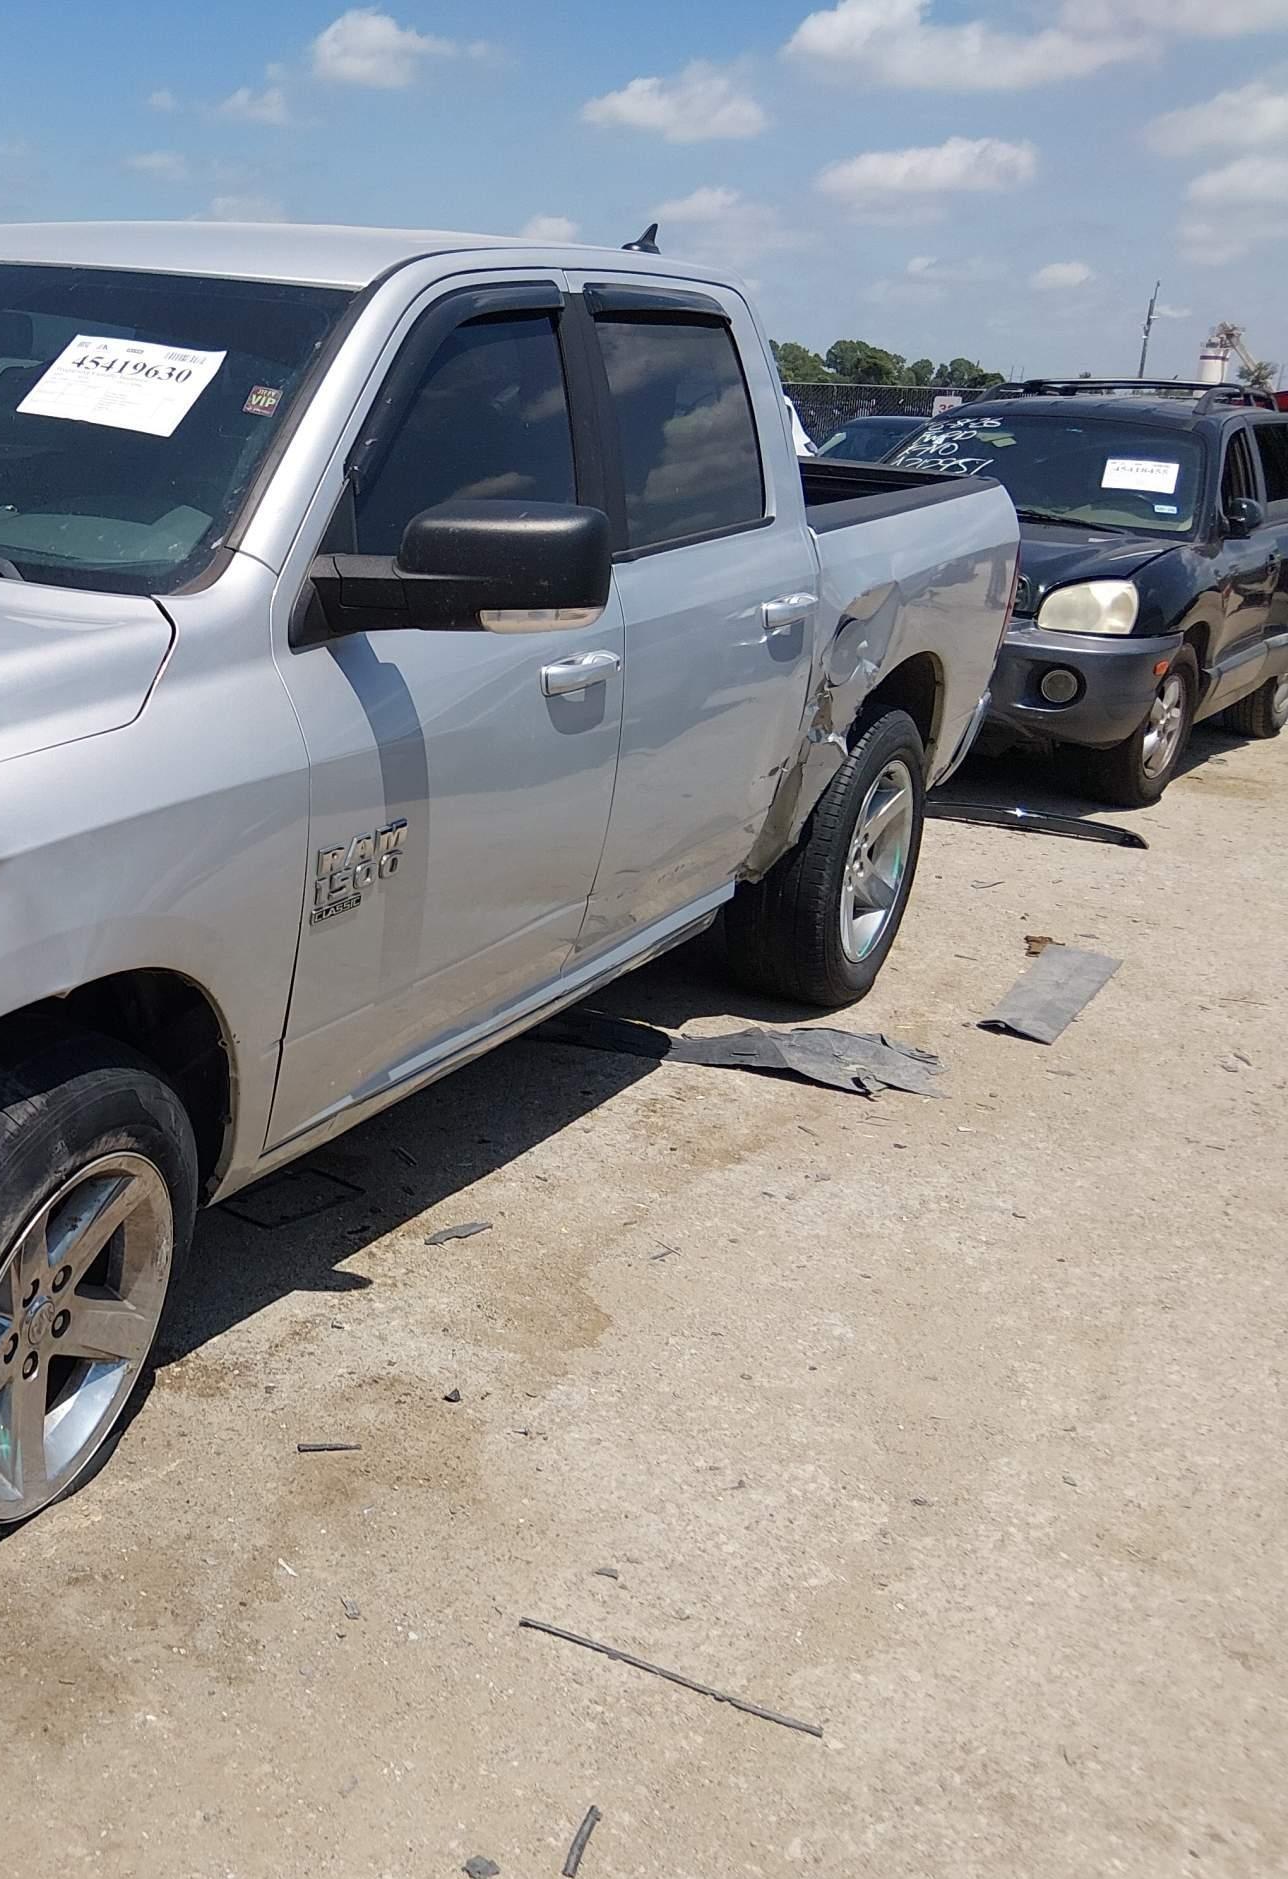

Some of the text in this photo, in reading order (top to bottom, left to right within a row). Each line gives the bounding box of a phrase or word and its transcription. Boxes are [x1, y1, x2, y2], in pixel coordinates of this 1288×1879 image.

[72, 354, 193, 384] 45419630
[251, 394, 276, 407] VIP
[316, 818, 408, 878] RAM
[314, 849, 403, 906] 1500
[313, 894, 361, 923] CLASSIC
